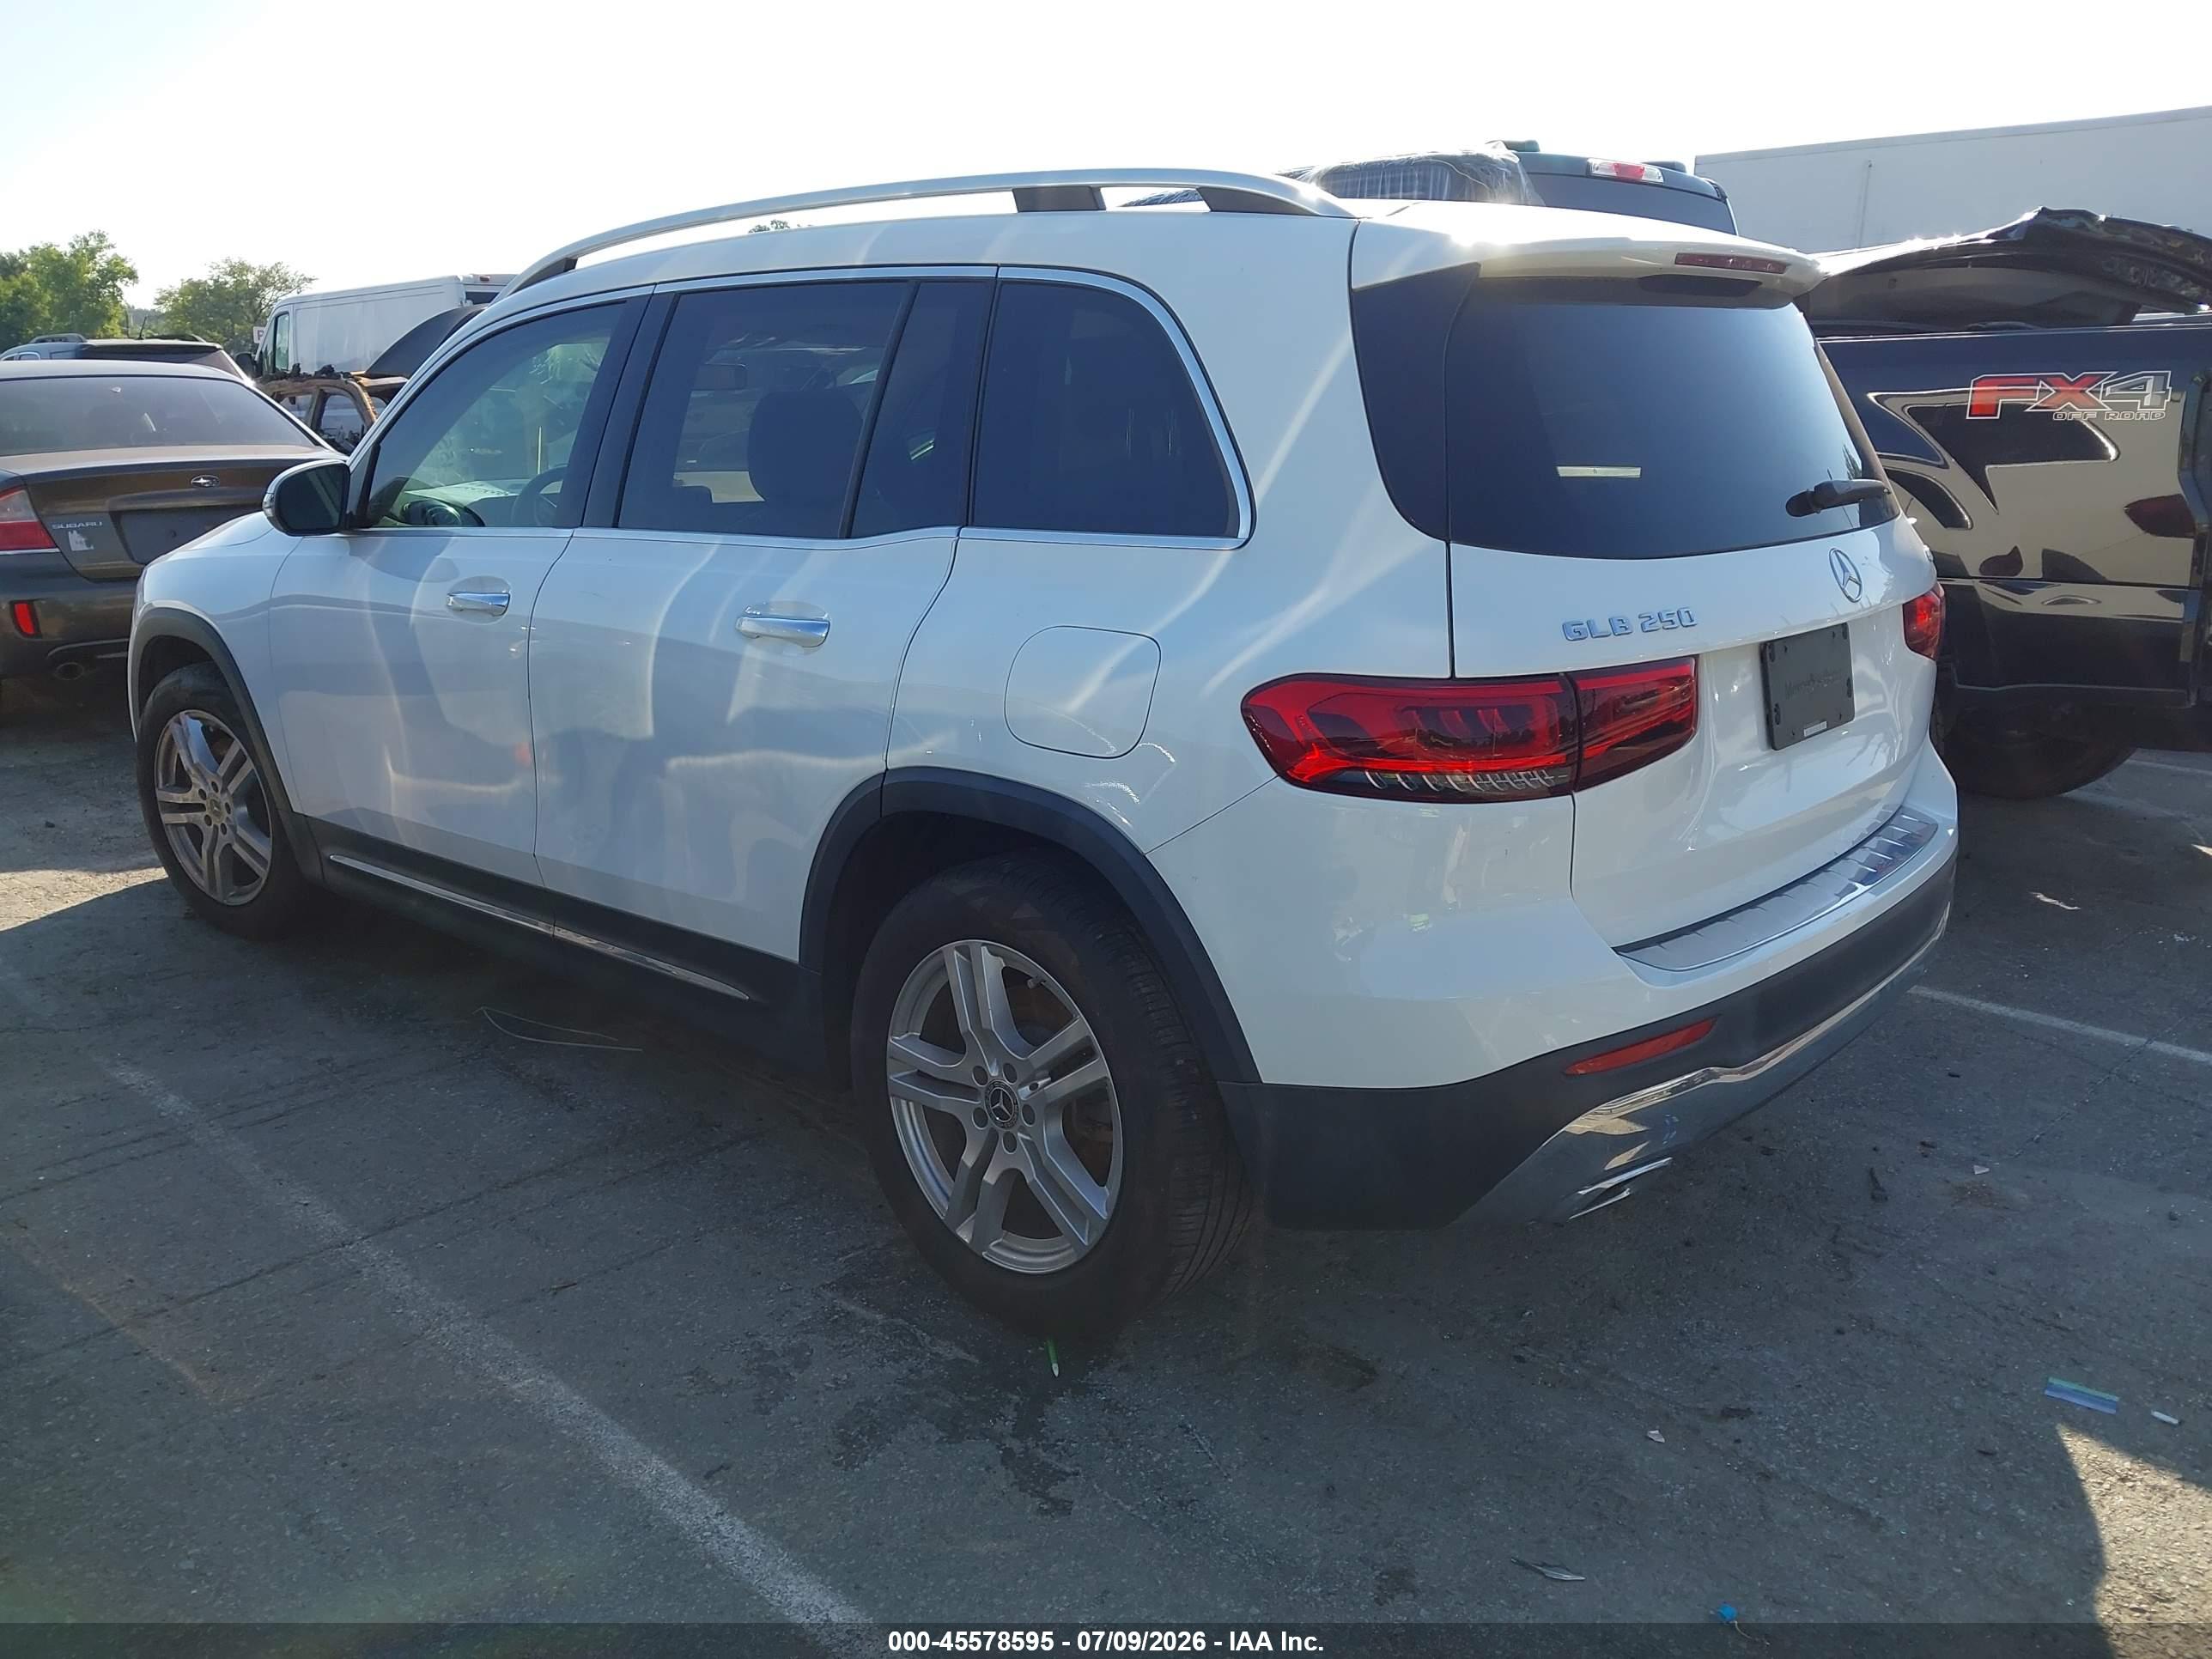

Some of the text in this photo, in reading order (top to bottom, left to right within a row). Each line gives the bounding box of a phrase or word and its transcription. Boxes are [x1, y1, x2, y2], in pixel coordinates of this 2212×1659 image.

[1966, 371, 2172, 419] FX4
[2053, 411, 2166, 421] OFF ROAD
[1562, 607, 1697, 641] GLB 250
